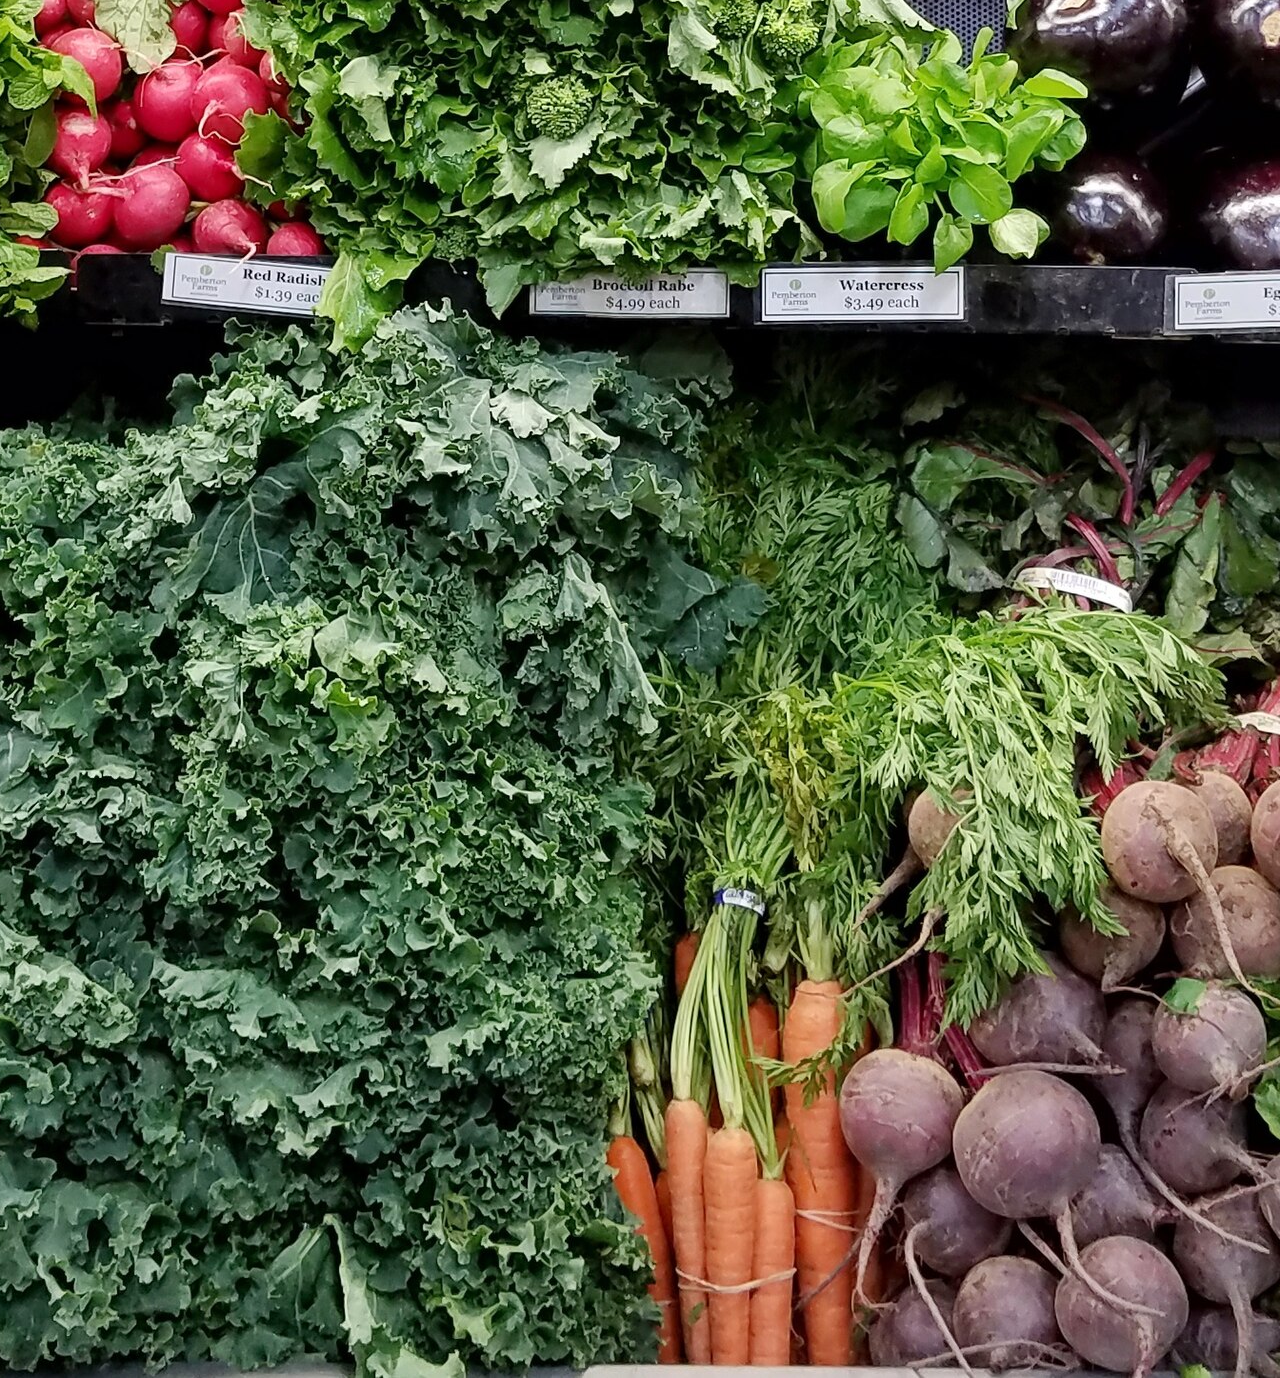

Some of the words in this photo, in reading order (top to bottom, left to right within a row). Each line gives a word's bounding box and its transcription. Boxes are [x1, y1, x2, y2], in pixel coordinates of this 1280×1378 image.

[181, 274, 227, 286] Pemberton
[243, 268, 271, 281] Red
[192, 283, 218, 292] Farms
[658, 279, 695, 291] Rabe
[839, 279, 924, 291] Watercress
[255, 286, 292, 302] $1.39
[296, 292, 322, 304] eac
[771, 290, 817, 299] Pemberton
[605, 296, 646, 311] $4.99
[649, 296, 680, 309] each
[783, 298, 808, 306] Farms
[844, 296, 884, 310] $3.49
[888, 295, 919, 308] each
[1185, 299, 1230, 310] Pemberton
[1196, 306, 1222, 315] Farms
